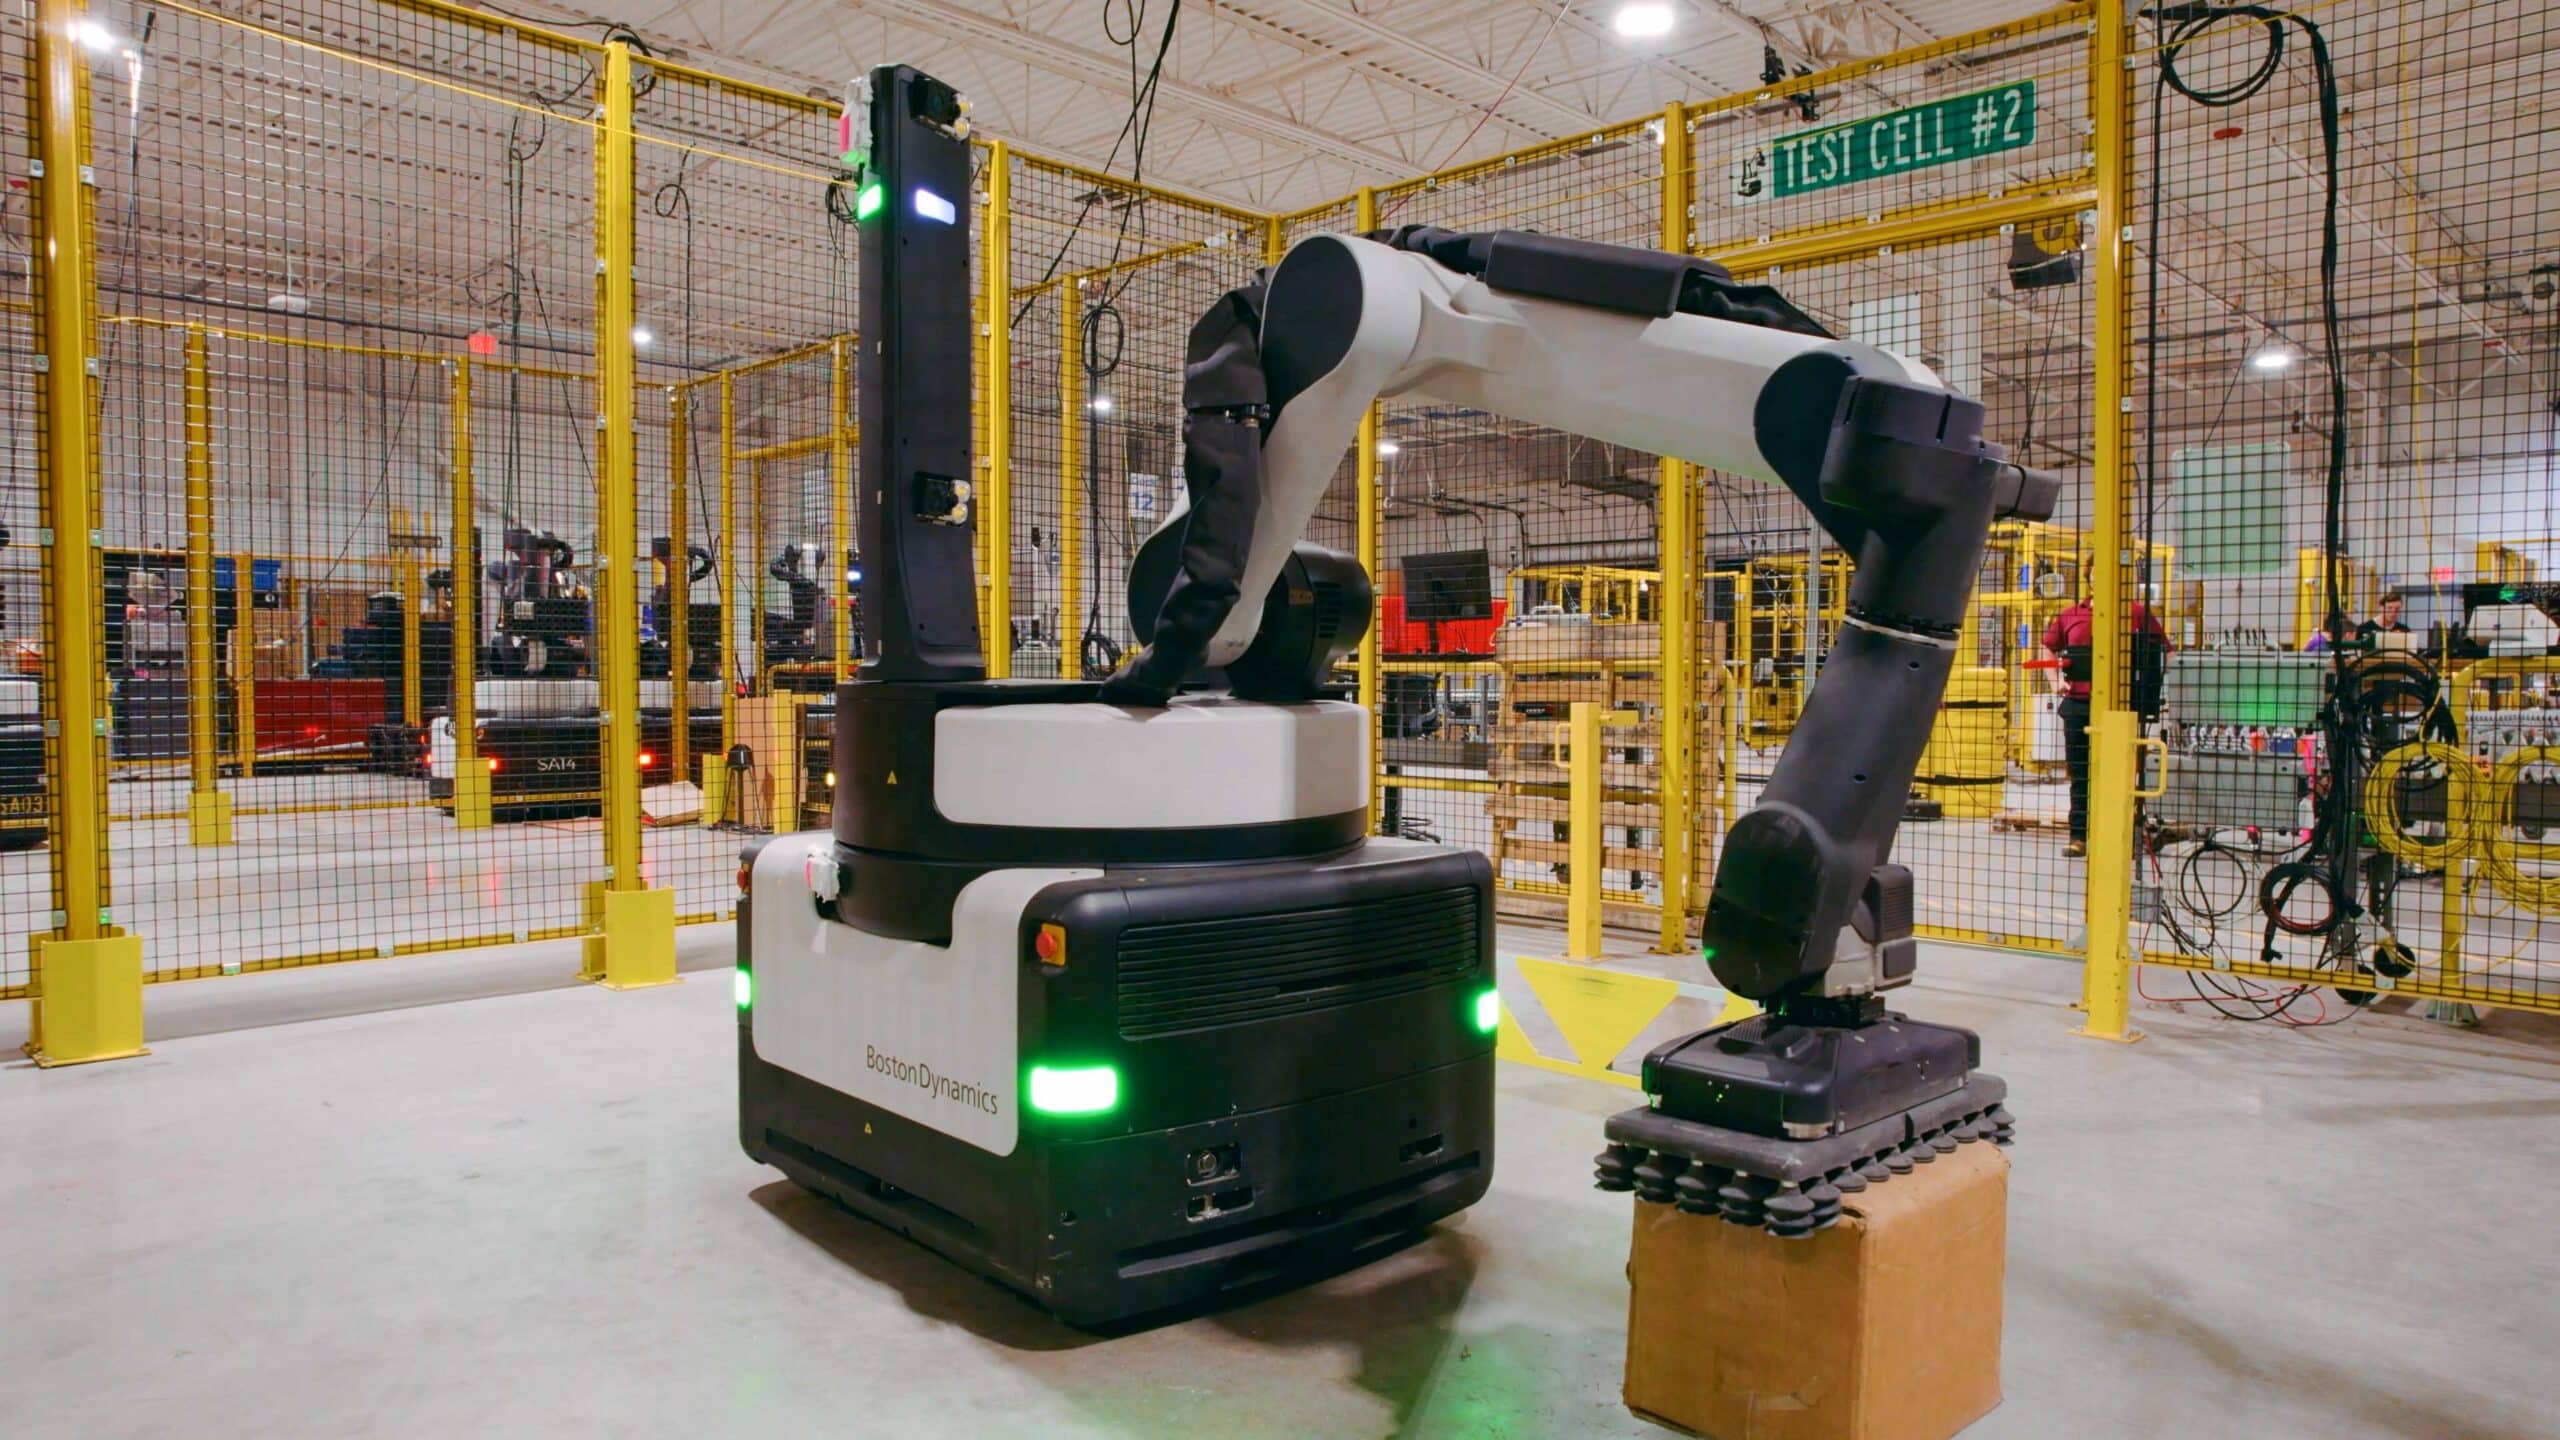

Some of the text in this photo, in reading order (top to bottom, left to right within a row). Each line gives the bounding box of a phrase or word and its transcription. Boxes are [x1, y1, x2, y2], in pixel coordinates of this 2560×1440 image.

[1783, 89, 2022, 188] TEST CELL #2
